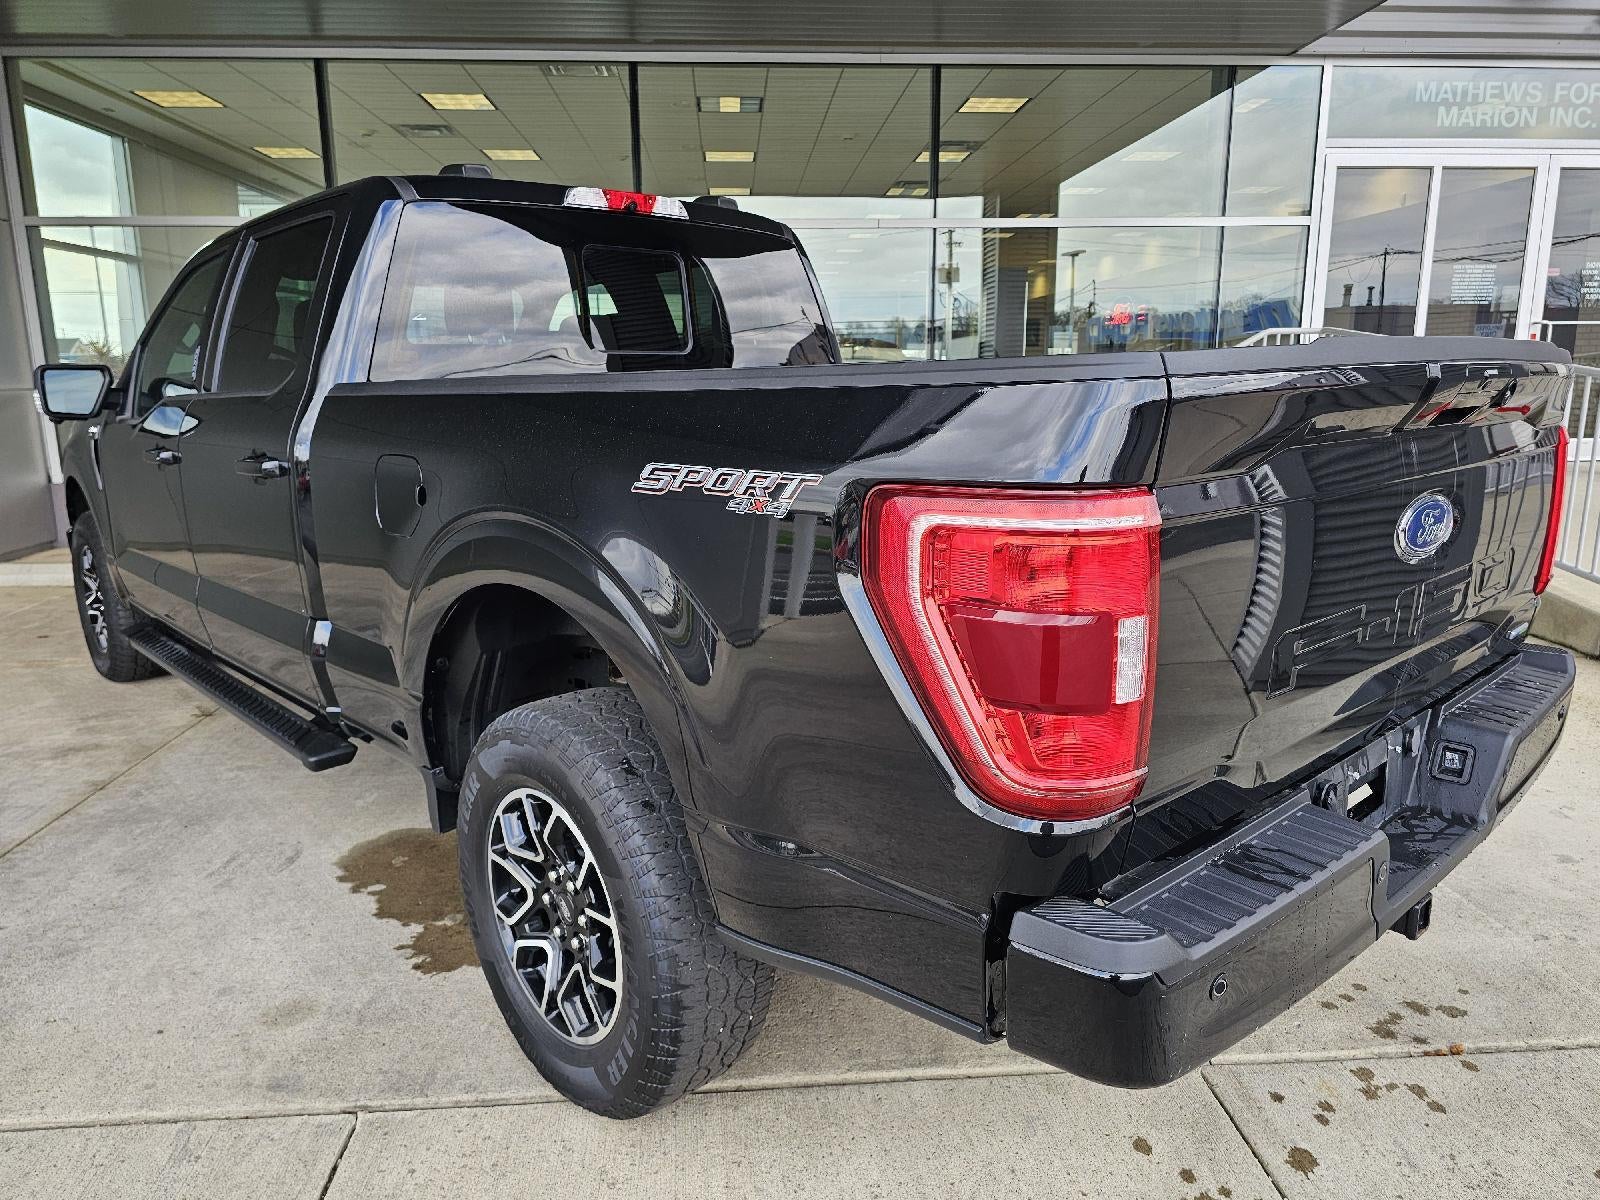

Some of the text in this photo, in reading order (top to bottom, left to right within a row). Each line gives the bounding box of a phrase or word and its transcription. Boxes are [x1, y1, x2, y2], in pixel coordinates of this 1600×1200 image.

[1415, 81, 1543, 103] MATHEWS
[1437, 106, 1597, 128] MARION INC.
[631, 462, 824, 501] SPORT
[1416, 508, 1446, 545] Ford
